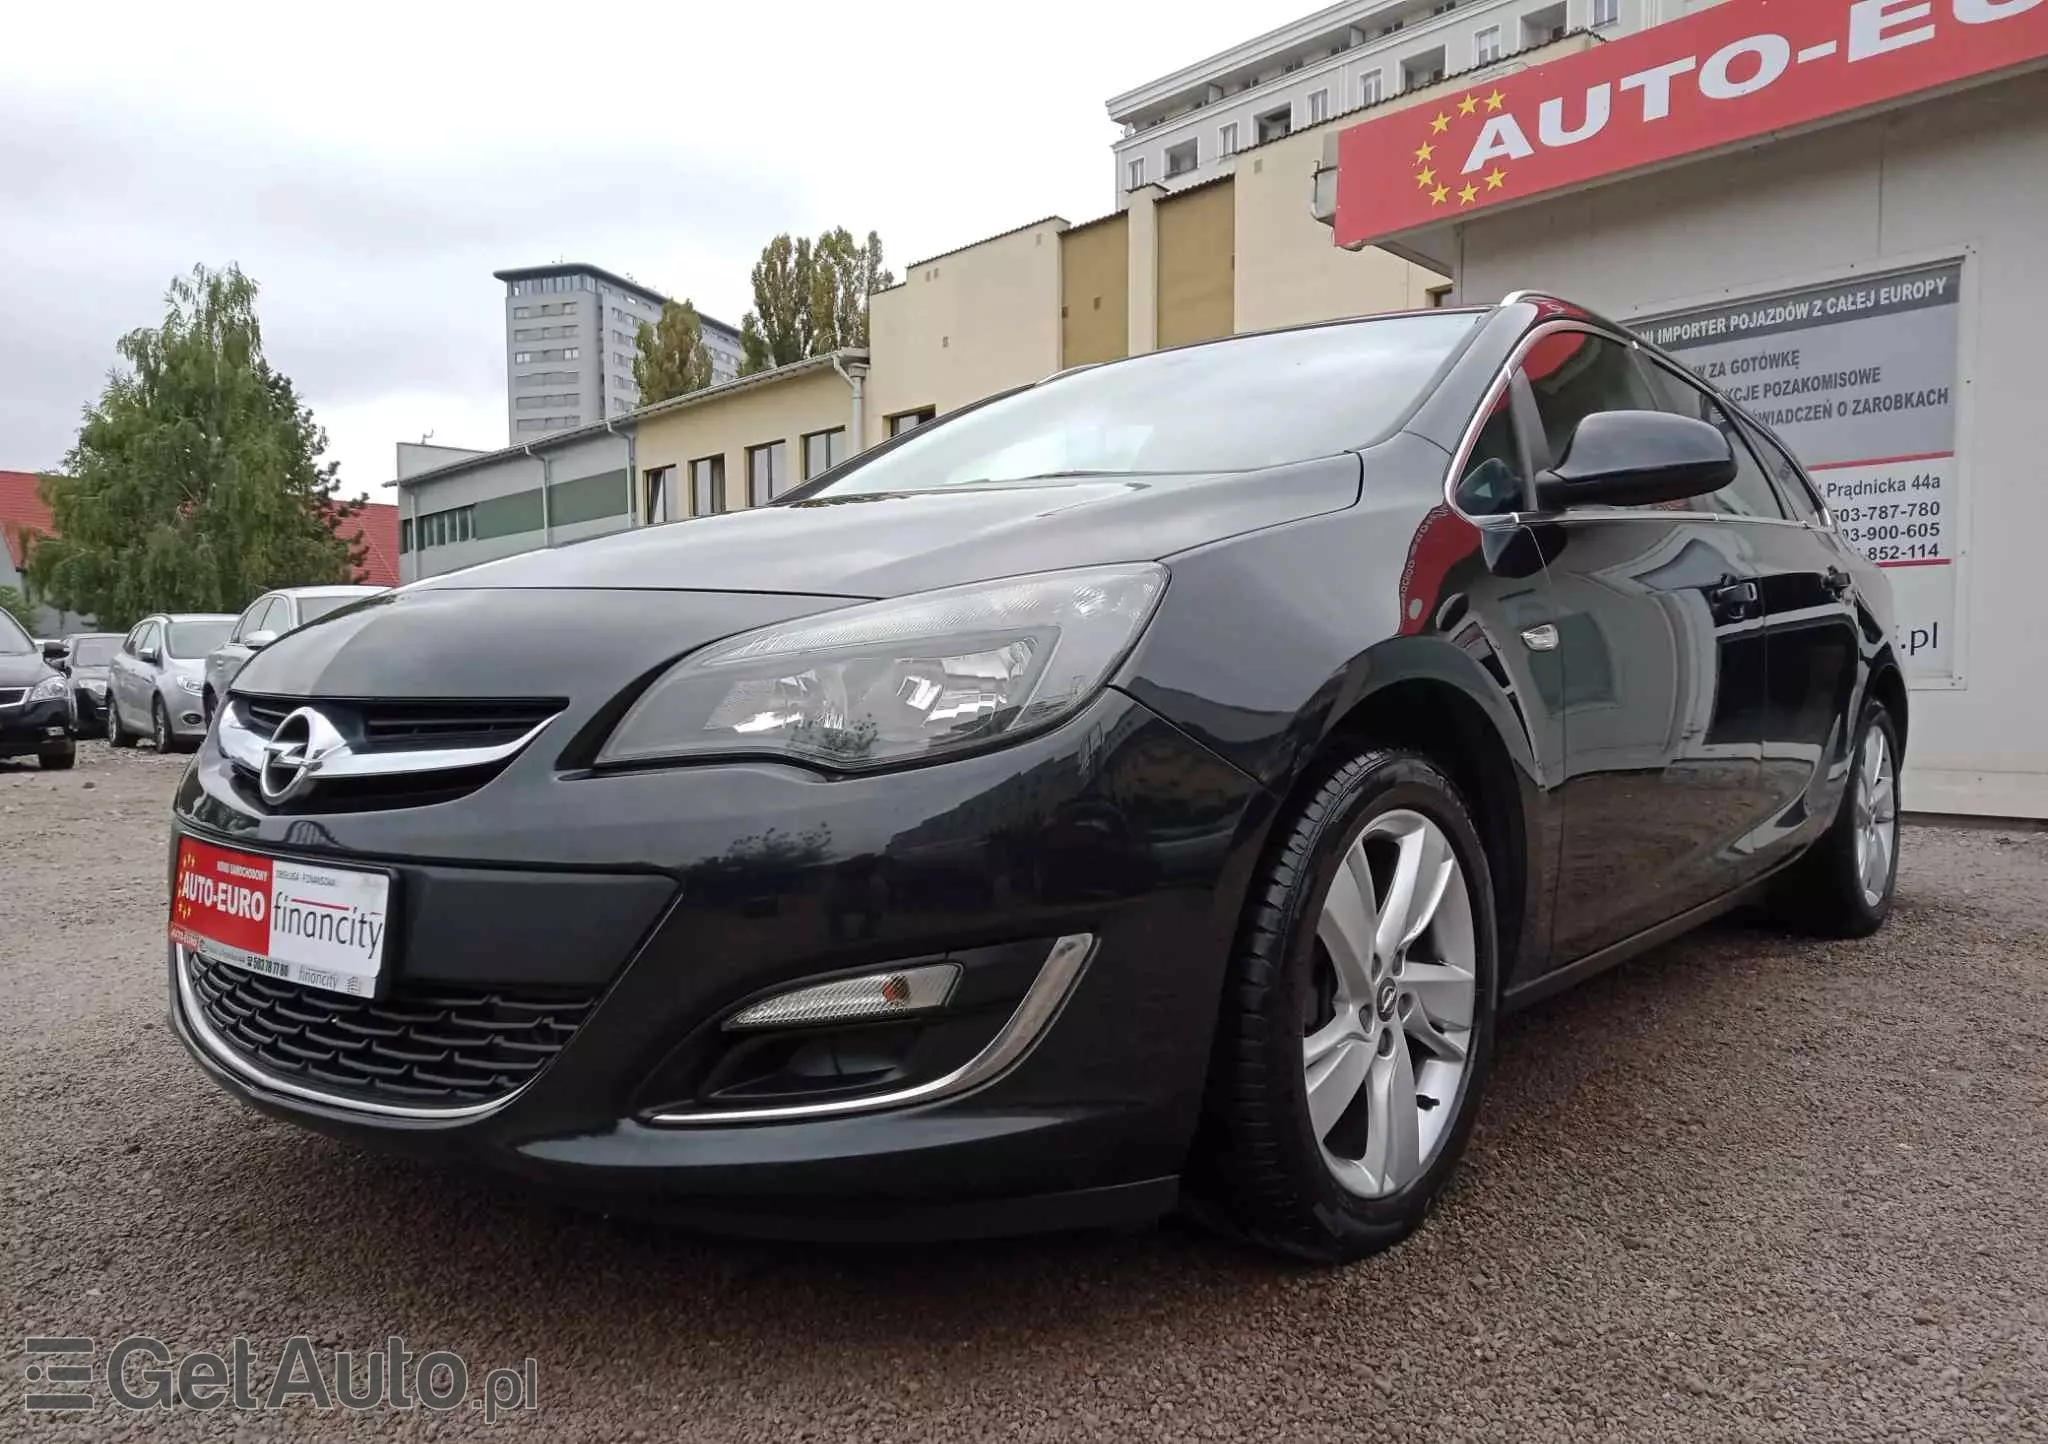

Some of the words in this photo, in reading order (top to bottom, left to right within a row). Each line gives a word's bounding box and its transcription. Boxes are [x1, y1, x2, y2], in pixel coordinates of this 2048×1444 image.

[1657, 317, 1727, 345] IMPORTER
[1730, 300, 1809, 332] POJAZDÓW
[1812, 299, 1823, 317] Z
[1826, 289, 1876, 314] CAŁEJ
[1879, 276, 1948, 305] EUROPY
[1709, 362, 1726, 378] ZA
[1730, 348, 1801, 375] GOTÓWKĘ
[1723, 384, 1760, 402] KCJE
[1763, 366, 1881, 399] POZAKOMISOWE
[1837, 401, 1848, 417] O
[1851, 387, 1949, 416] ZAROBKACH
[1827, 477, 1906, 500] Prądnicka
[1911, 473, 1941, 491] 44a
[182, 871, 265, 922] AUTO-EURO
[274, 891, 383, 960] financity
